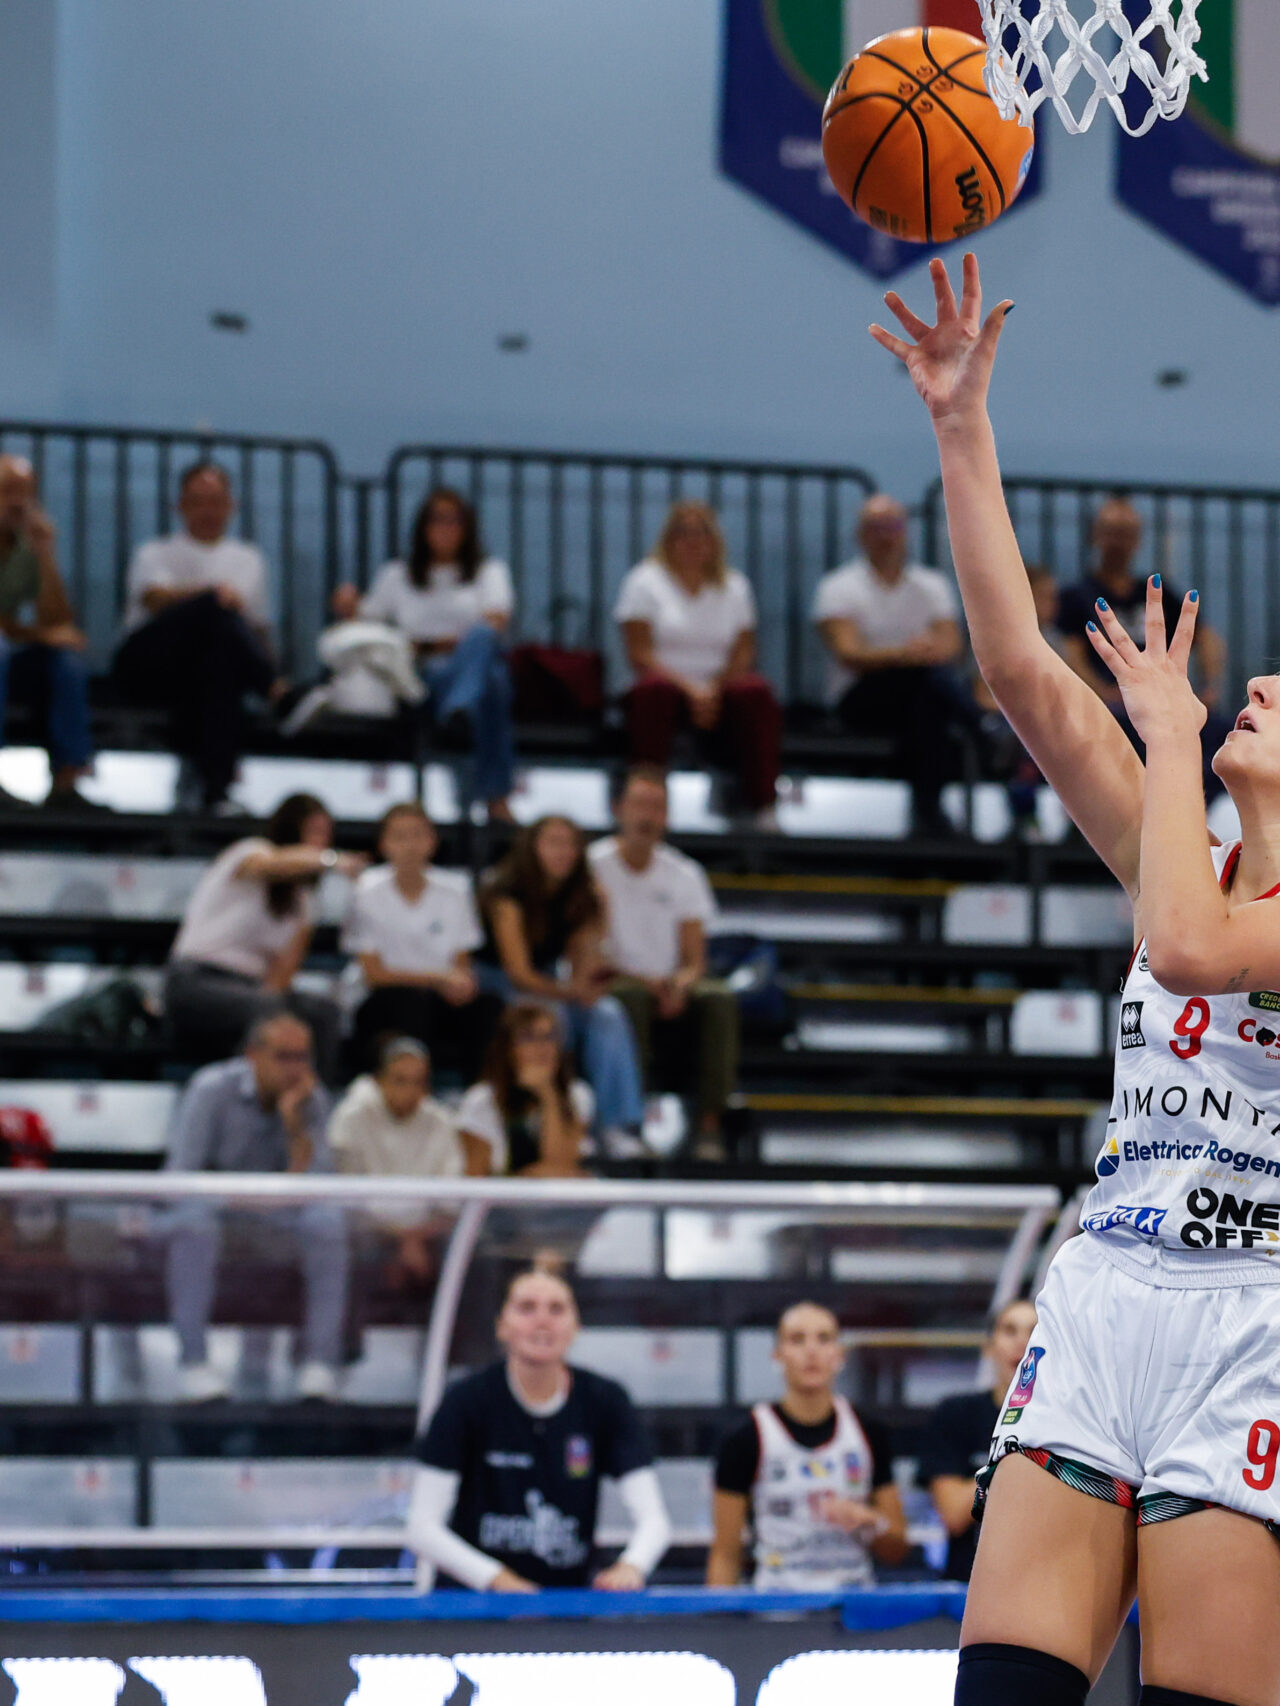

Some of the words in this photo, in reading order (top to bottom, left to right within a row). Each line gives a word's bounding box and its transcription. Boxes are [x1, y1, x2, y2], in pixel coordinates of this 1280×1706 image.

[1169, 996, 1210, 1060] 9
[1180, 1220, 1264, 1249] OFF
[1242, 1419, 1280, 1491] 9
